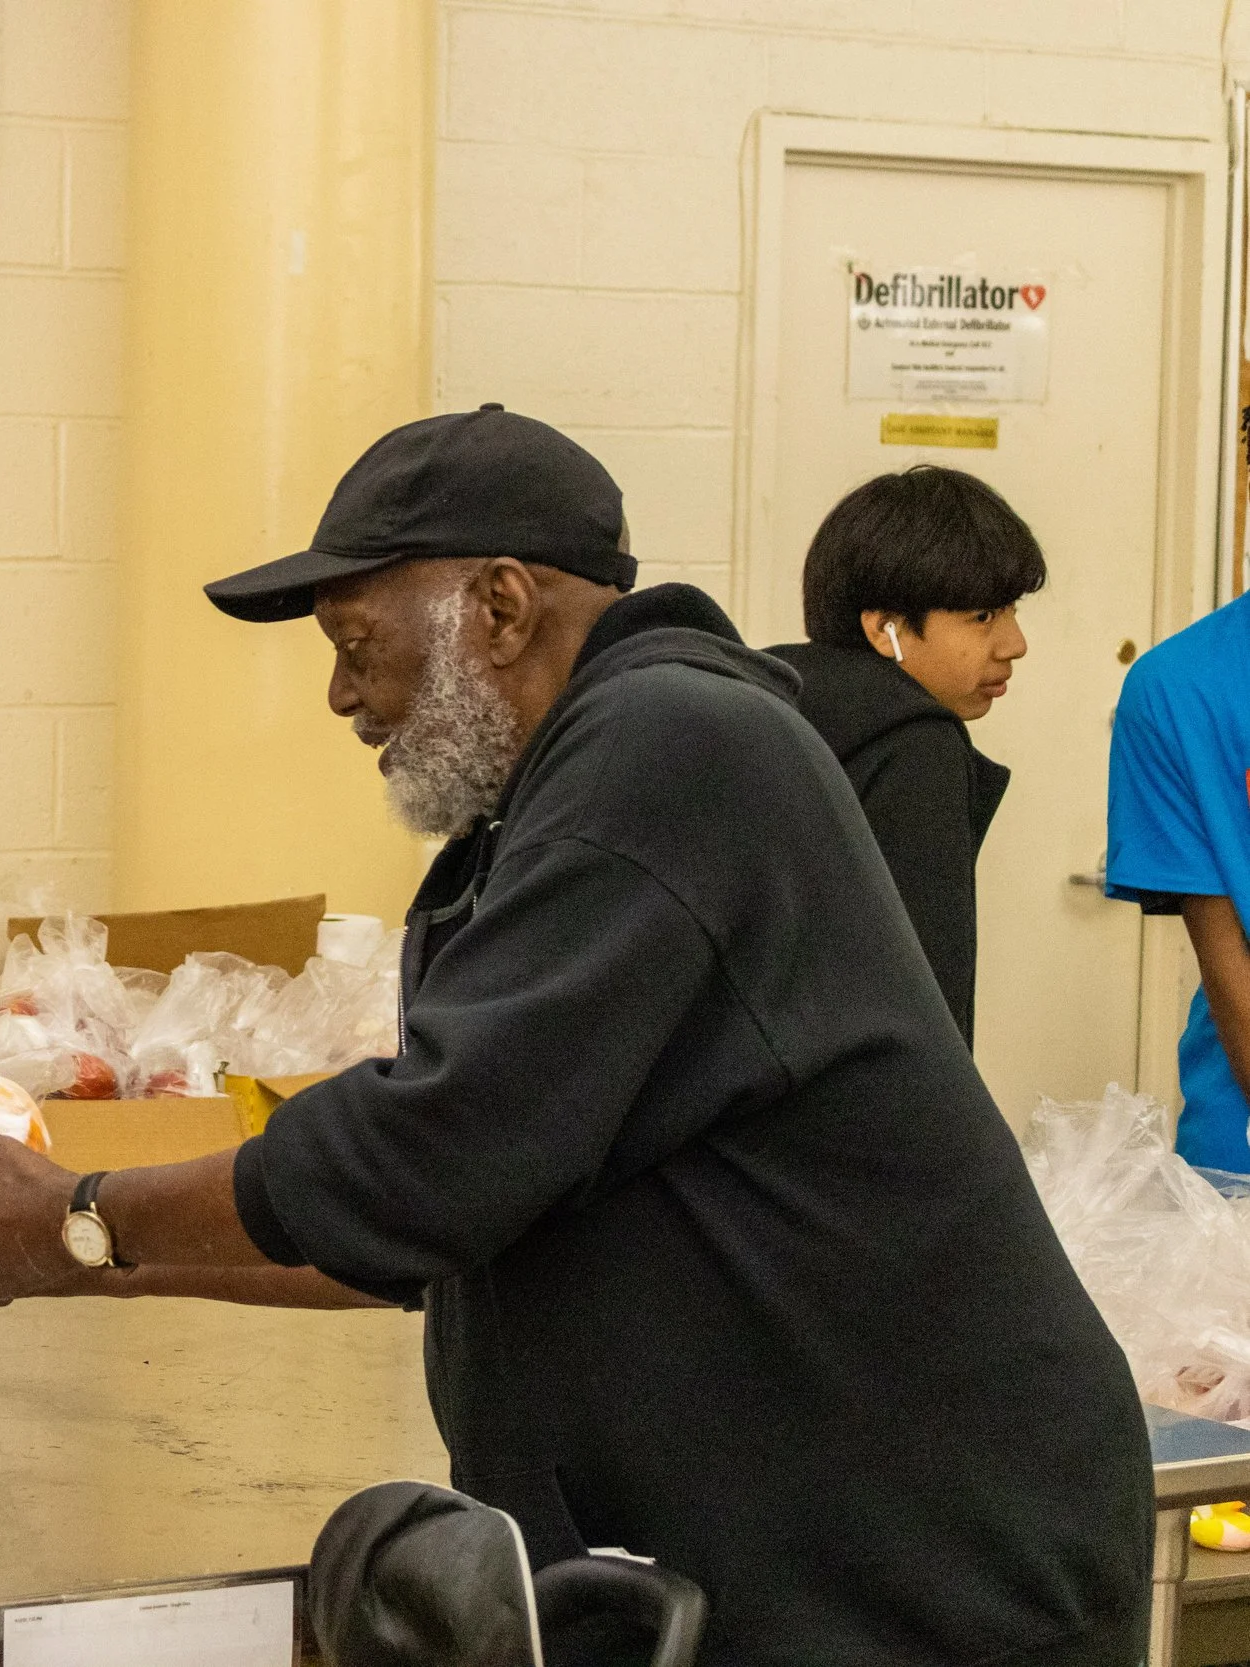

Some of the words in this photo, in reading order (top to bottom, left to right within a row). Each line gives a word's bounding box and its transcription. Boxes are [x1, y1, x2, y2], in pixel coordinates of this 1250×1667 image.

[855, 272, 1019, 310] Defibrillator
[923, 317, 956, 329] External
[960, 318, 1011, 332] Defibrillator
